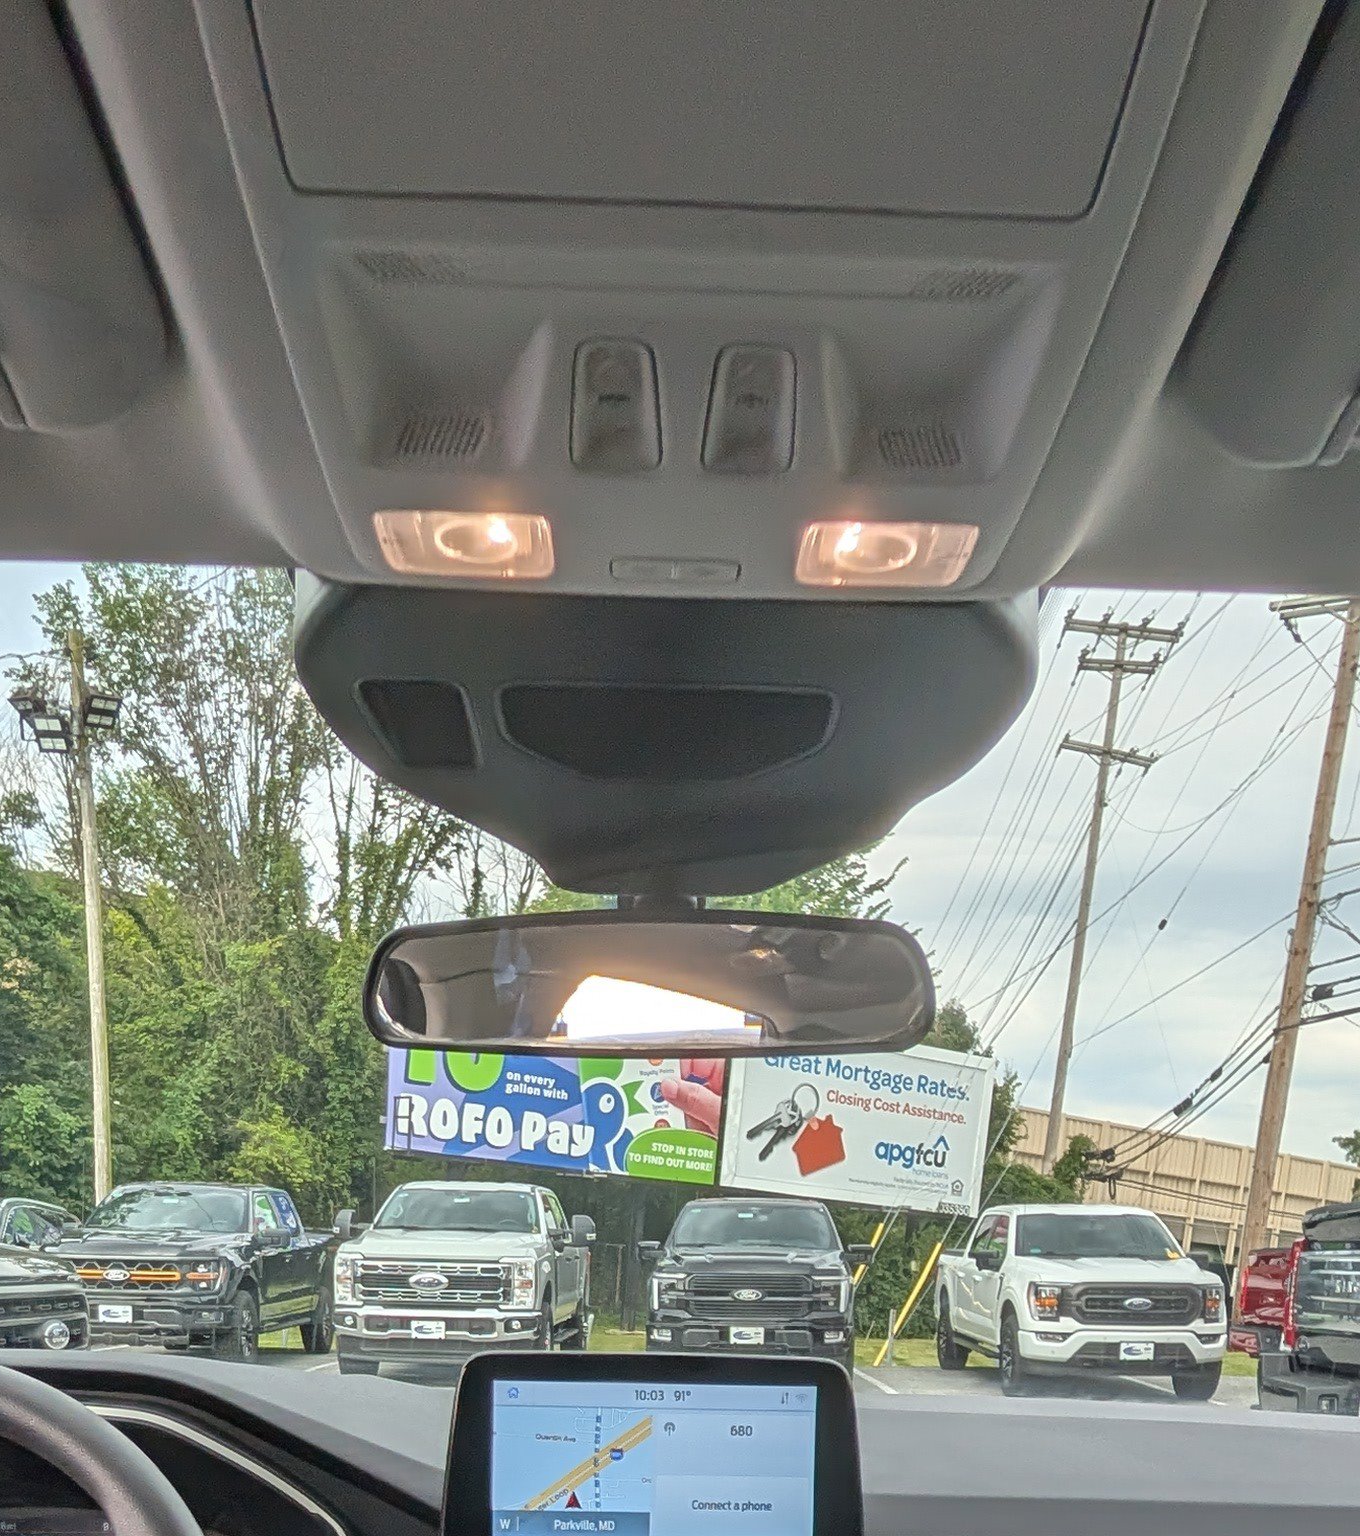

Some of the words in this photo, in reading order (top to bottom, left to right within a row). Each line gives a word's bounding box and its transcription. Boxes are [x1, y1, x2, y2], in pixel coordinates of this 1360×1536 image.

[506, 1071, 521, 1082] on
[523, 1072, 556, 1088] every
[825, 1058, 913, 1094] Mortgage
[916, 1074, 970, 1101] Rates.
[504, 1081, 541, 1097] gallon
[542, 1087, 569, 1101] with
[826, 1089, 871, 1112] Closing
[873, 1097, 901, 1114] Cost
[902, 1102, 967, 1125] Assistance.
[397, 1092, 514, 1148] ROFO
[520, 1110, 595, 1158] Pay
[651, 1142, 675, 1152] STOP
[675, 1145, 686, 1155] IN
[687, 1147, 714, 1159] STORE
[874, 1141, 947, 1169] apgfcu
[629, 1152, 642, 1162] TO
[643, 1154, 664, 1165] FIND
[665, 1157, 685, 1168] OUT
[685, 1160, 713, 1172] MORE!
[634, 1389, 664, 1401] 10:03
[673, 1390, 691, 1401] 91°
[730, 1425, 753, 1437] 680
[691, 1500, 731, 1511] Connect
[733, 1503, 740, 1511] a
[741, 1501, 772, 1512] phone
[499, 1519, 511, 1529] W
[554, 1519, 597, 1531] Parkville,
[599, 1521, 615, 1530] MD
